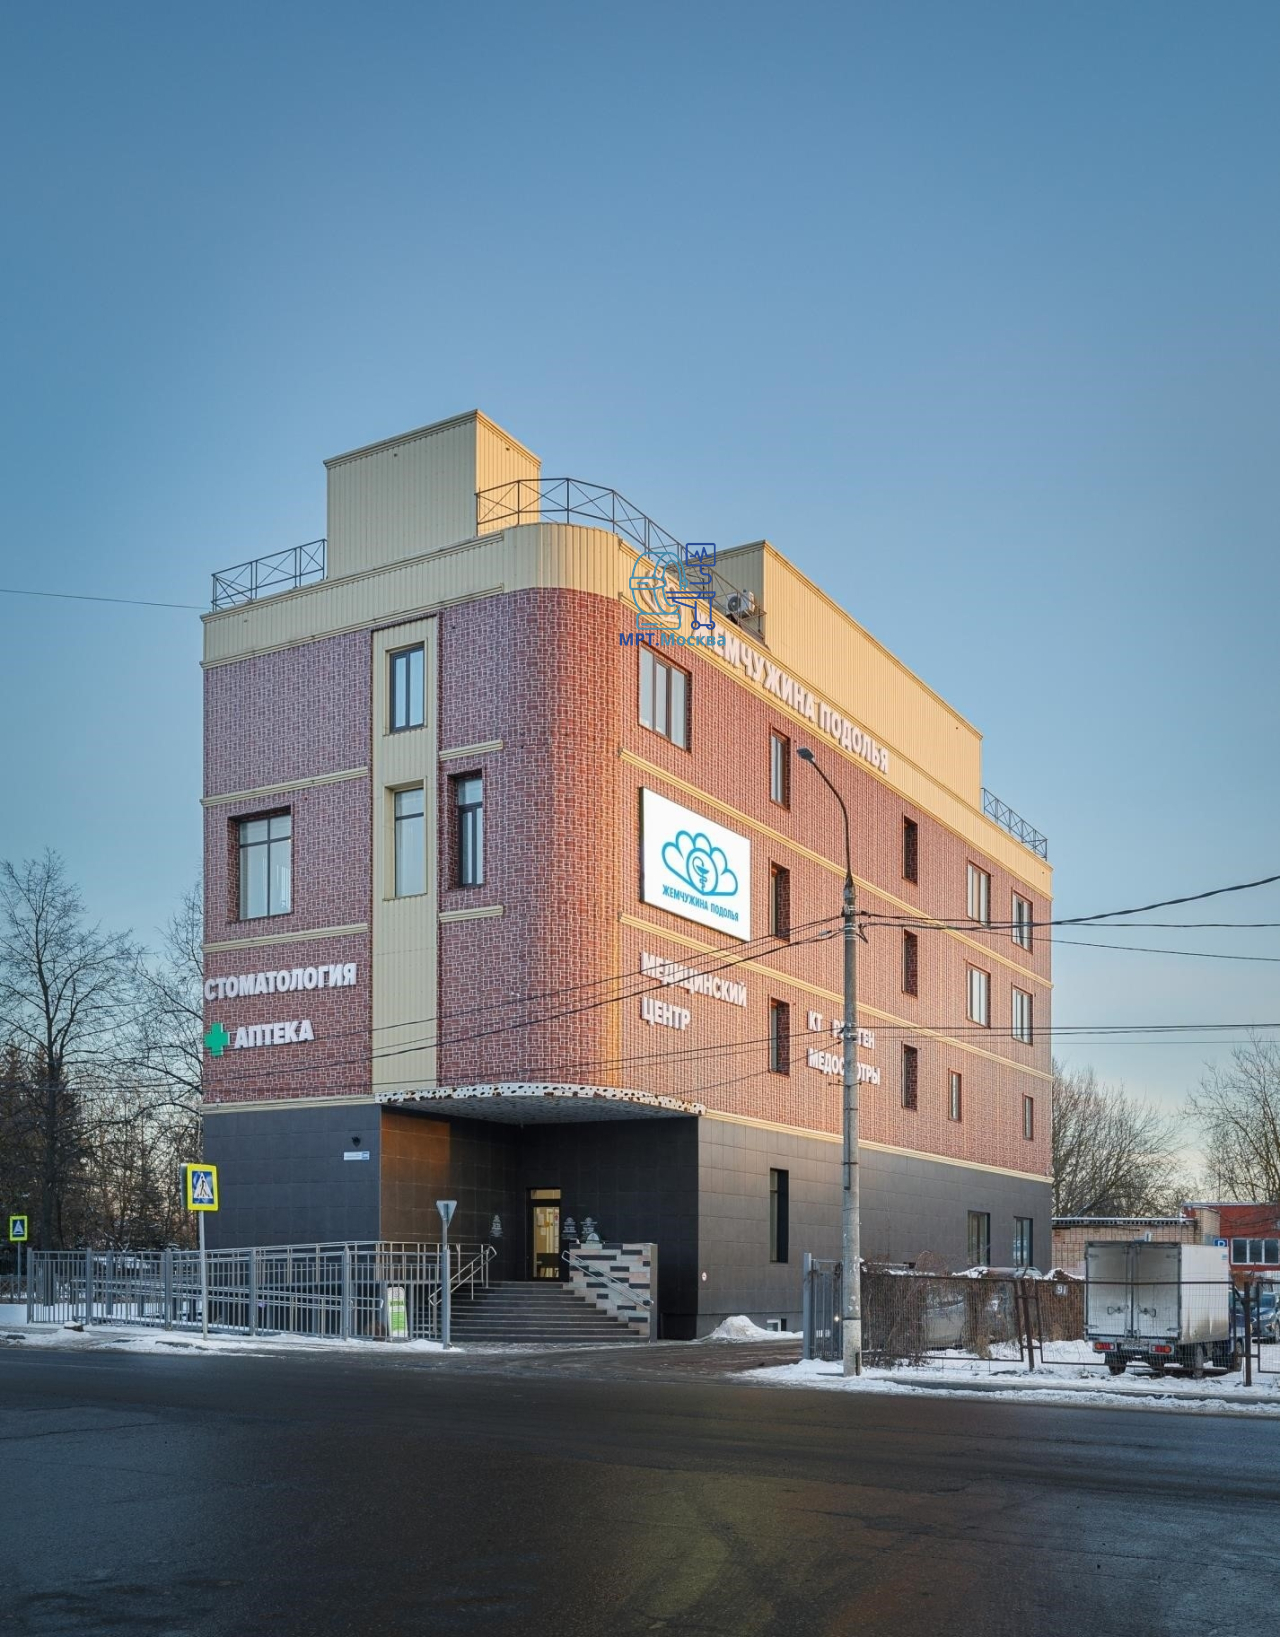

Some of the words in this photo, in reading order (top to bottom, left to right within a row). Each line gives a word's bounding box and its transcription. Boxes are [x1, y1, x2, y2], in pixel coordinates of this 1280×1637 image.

[691, 608, 816, 723] ЖЕМЧУЖИНА
[819, 701, 889, 774] ПОДОЛЬЯ
[662, 884, 708, 911] ЖЕМЧУЖИНА
[711, 902, 739, 922] ПОДОЛЬЯ
[204, 963, 357, 1001] СТОМАТОЛОГИЯ
[640, 951, 747, 1008] МЕДИЦИНСКИЙ
[641, 996, 691, 1031] ЦЕНТР
[807, 1010, 823, 1032] КТ
[831, 1019, 875, 1050] РГЕН
[234, 1019, 315, 1050] АПТЕКА
[807, 1047, 881, 1086] МЕДОСОТРЫ
